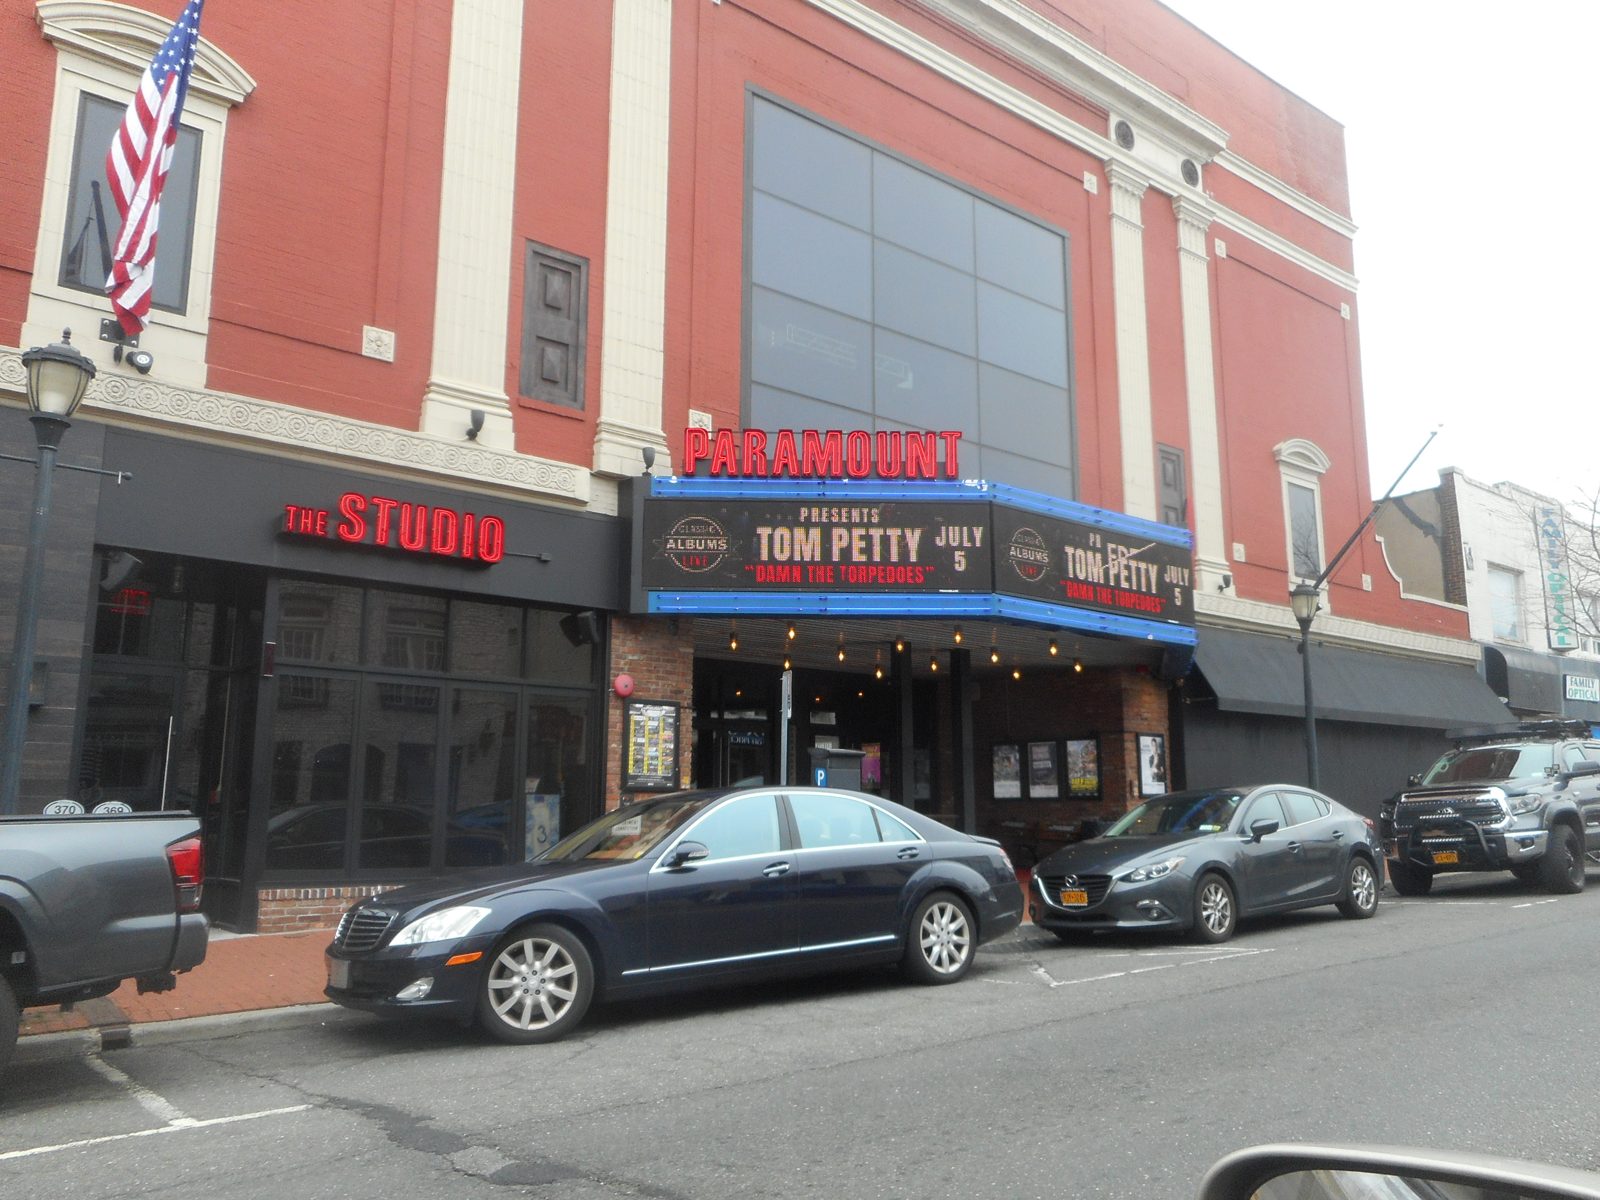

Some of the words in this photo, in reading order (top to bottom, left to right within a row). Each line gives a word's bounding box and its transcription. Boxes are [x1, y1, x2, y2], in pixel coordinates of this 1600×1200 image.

[685, 428, 962, 478] PARAMOUNT
[800, 507, 880, 523] PRESENTS
[284, 505, 328, 537] THE
[338, 492, 505, 563] STUDIO
[935, 526, 984, 547] JULY
[666, 539, 728, 550] ALBUMS
[756, 526, 821, 562] TOM
[832, 526, 923, 562] PETTY
[954, 550, 967, 571] 5
[1009, 546, 1049, 563] ALBUMS
[807, 565, 834, 584] THE
[1064, 545, 1105, 584] TOM
[1107, 558, 1158, 594] PETTY
[1164, 564, 1189, 587] JULY
[1096, 586, 1113, 605] THE
[1174, 587, 1182, 606] 5
[1570, 677, 1596, 688] FAMILY
[1568, 688, 1598, 700] OPTICAL
[817, 770, 825, 786] P
[54, 805, 76, 815] 370
[537, 825, 547, 844] 3
